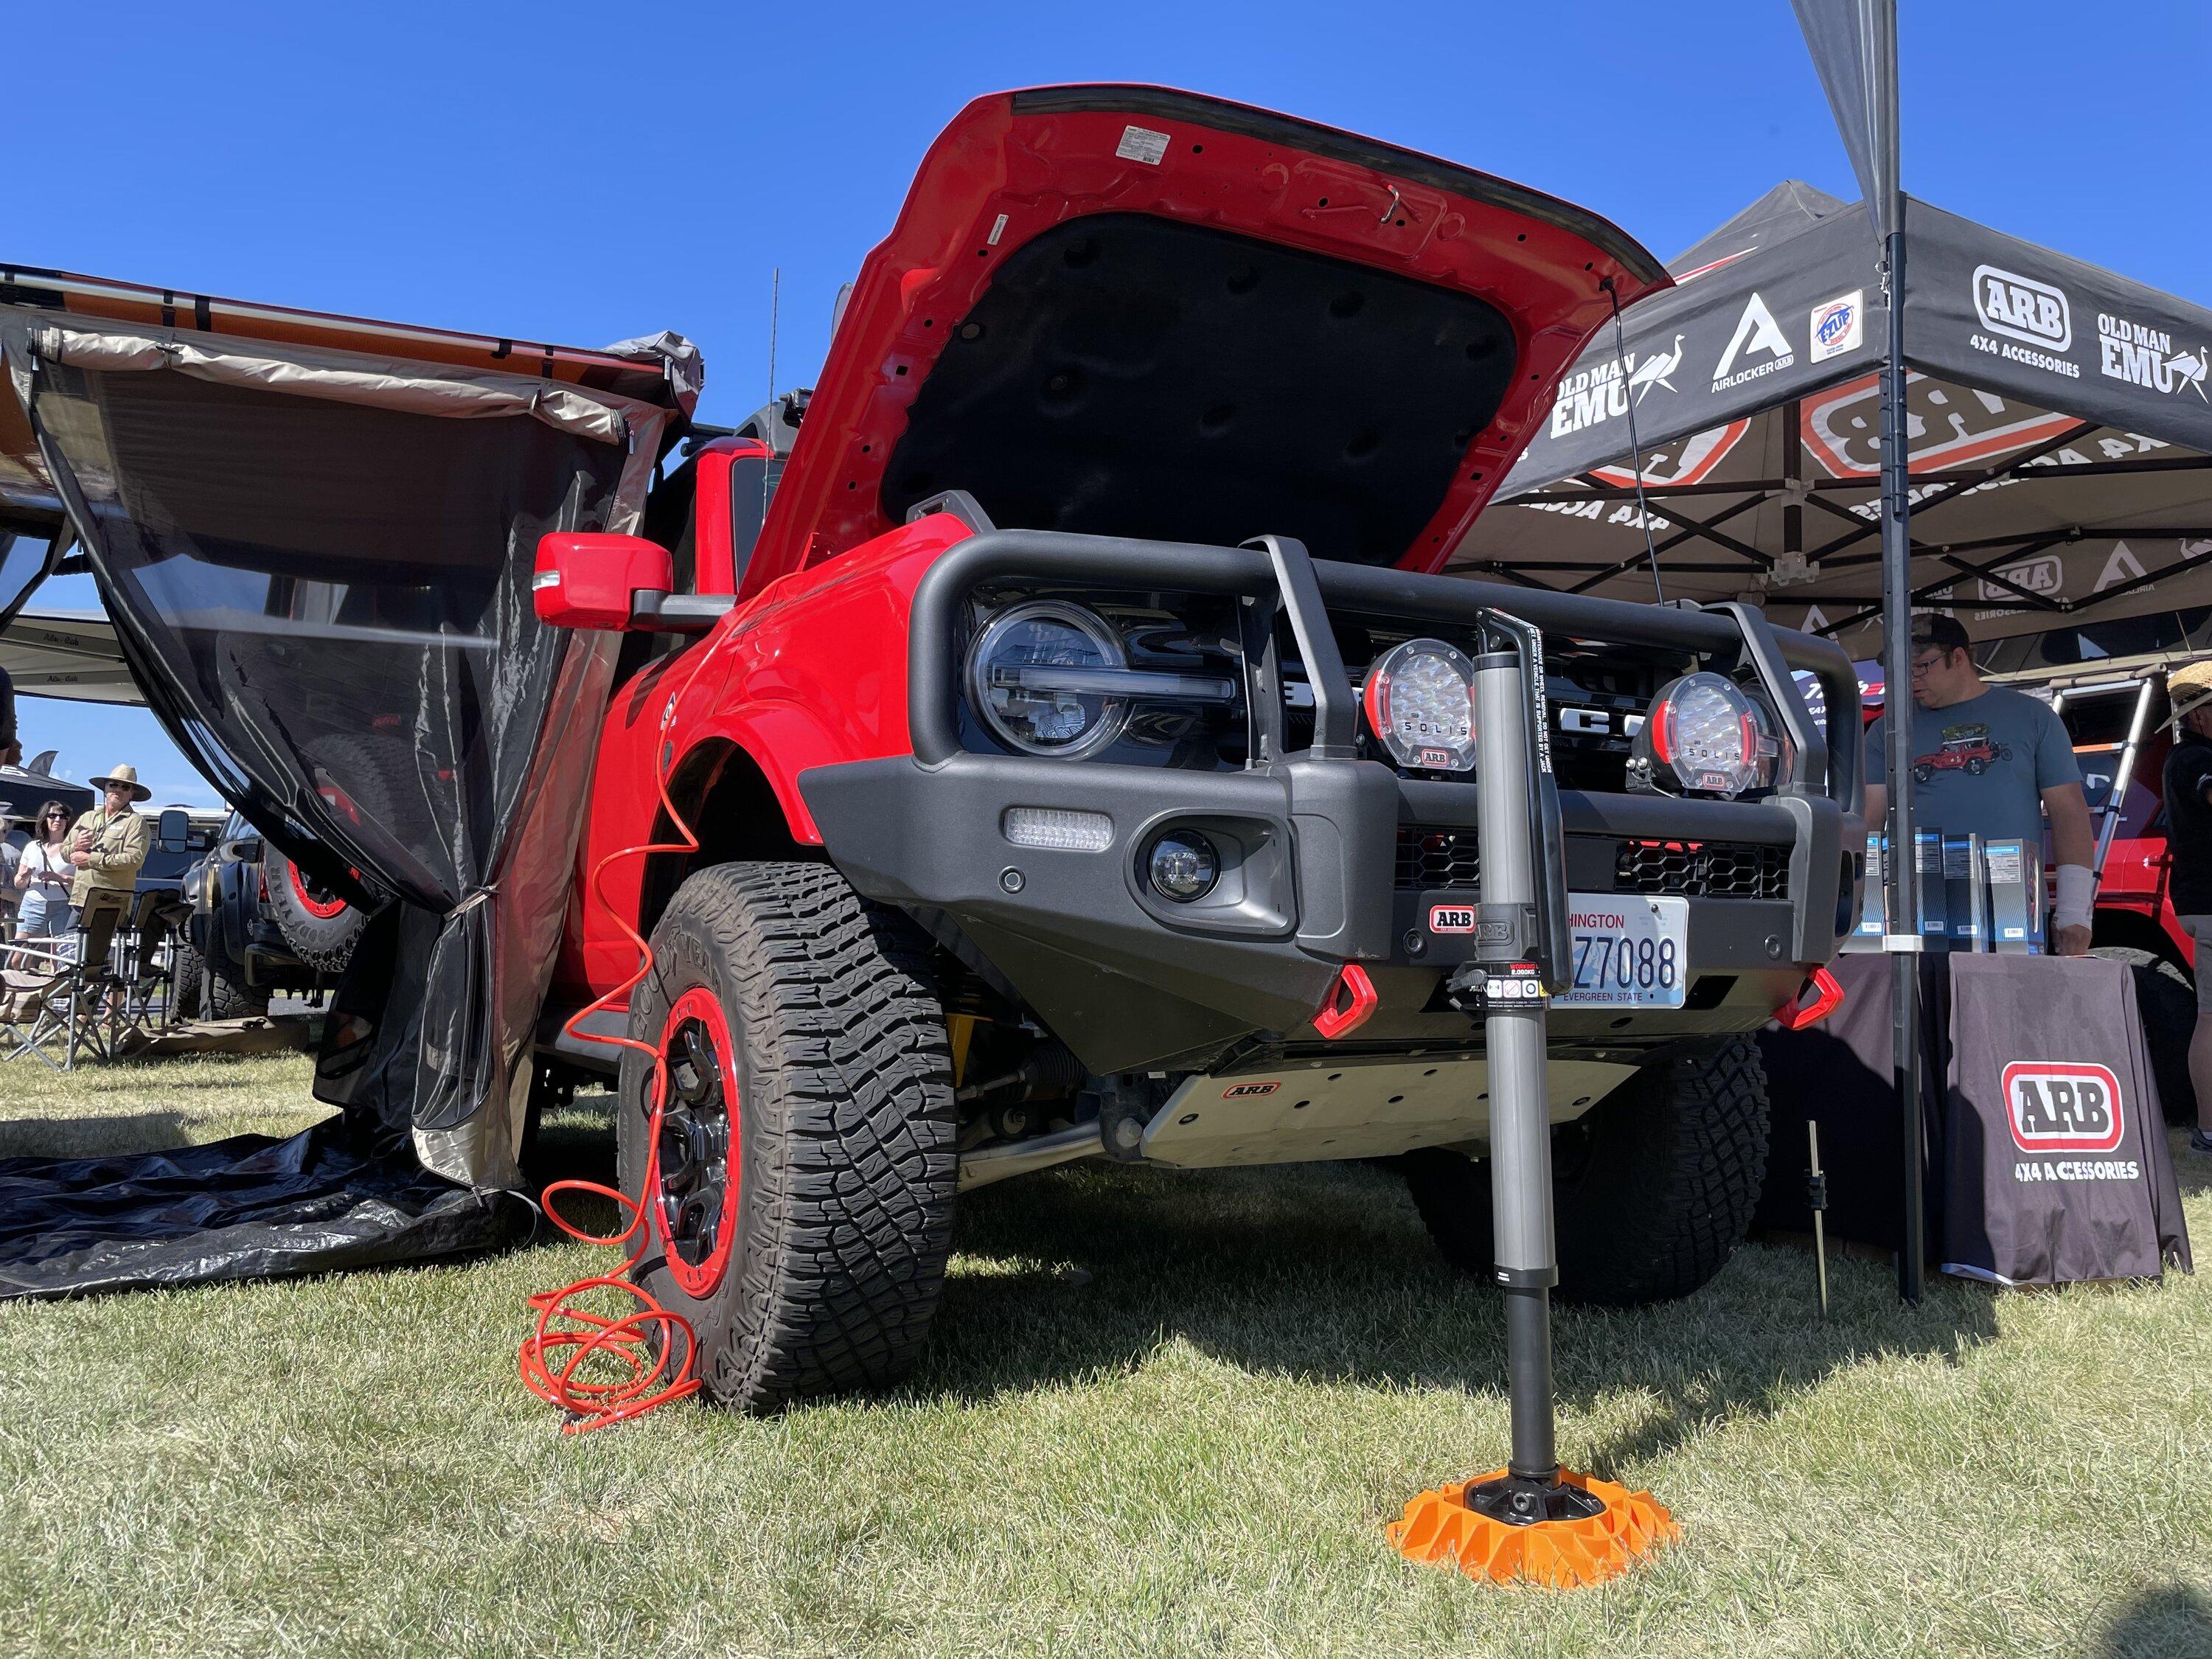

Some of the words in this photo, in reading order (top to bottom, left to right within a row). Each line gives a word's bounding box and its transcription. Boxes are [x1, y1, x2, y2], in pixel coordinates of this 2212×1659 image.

[1986, 279, 2063, 338] ARB
[2098, 313, 2131, 341] OLD
[2132, 324, 2171, 355] MAN
[1590, 352, 1635, 387] MAN
[1970, 334, 1998, 355] 4X4
[2002, 344, 2080, 378] ACCESSORIES
[2099, 334, 2173, 393] EMU
[1711, 362, 1774, 393] AIRLOCKER
[1777, 357, 1792, 368] ARB
[1550, 376, 1632, 439] EMU
[1535, 628, 1543, 666] MAINTENANCE
[1405, 722, 1467, 735] SOLIS
[1425, 752, 1446, 762] ARB
[1689, 748, 1740, 760] SOLIS
[1706, 776, 1723, 785] ARB
[1436, 911, 1472, 927] ARB
[1569, 914, 1624, 928] HINGTON
[1574, 936, 1675, 990] Z7088
[1563, 992, 1613, 1001] EVERGREEN
[1617, 992, 1643, 1001] STATE
[1228, 1085, 1275, 1096] ARB
[2018, 1080, 2110, 1133] ARB
[2015, 1163, 2042, 1182] 4X4
[2045, 1161, 2139, 1181] ACCESSORIES
